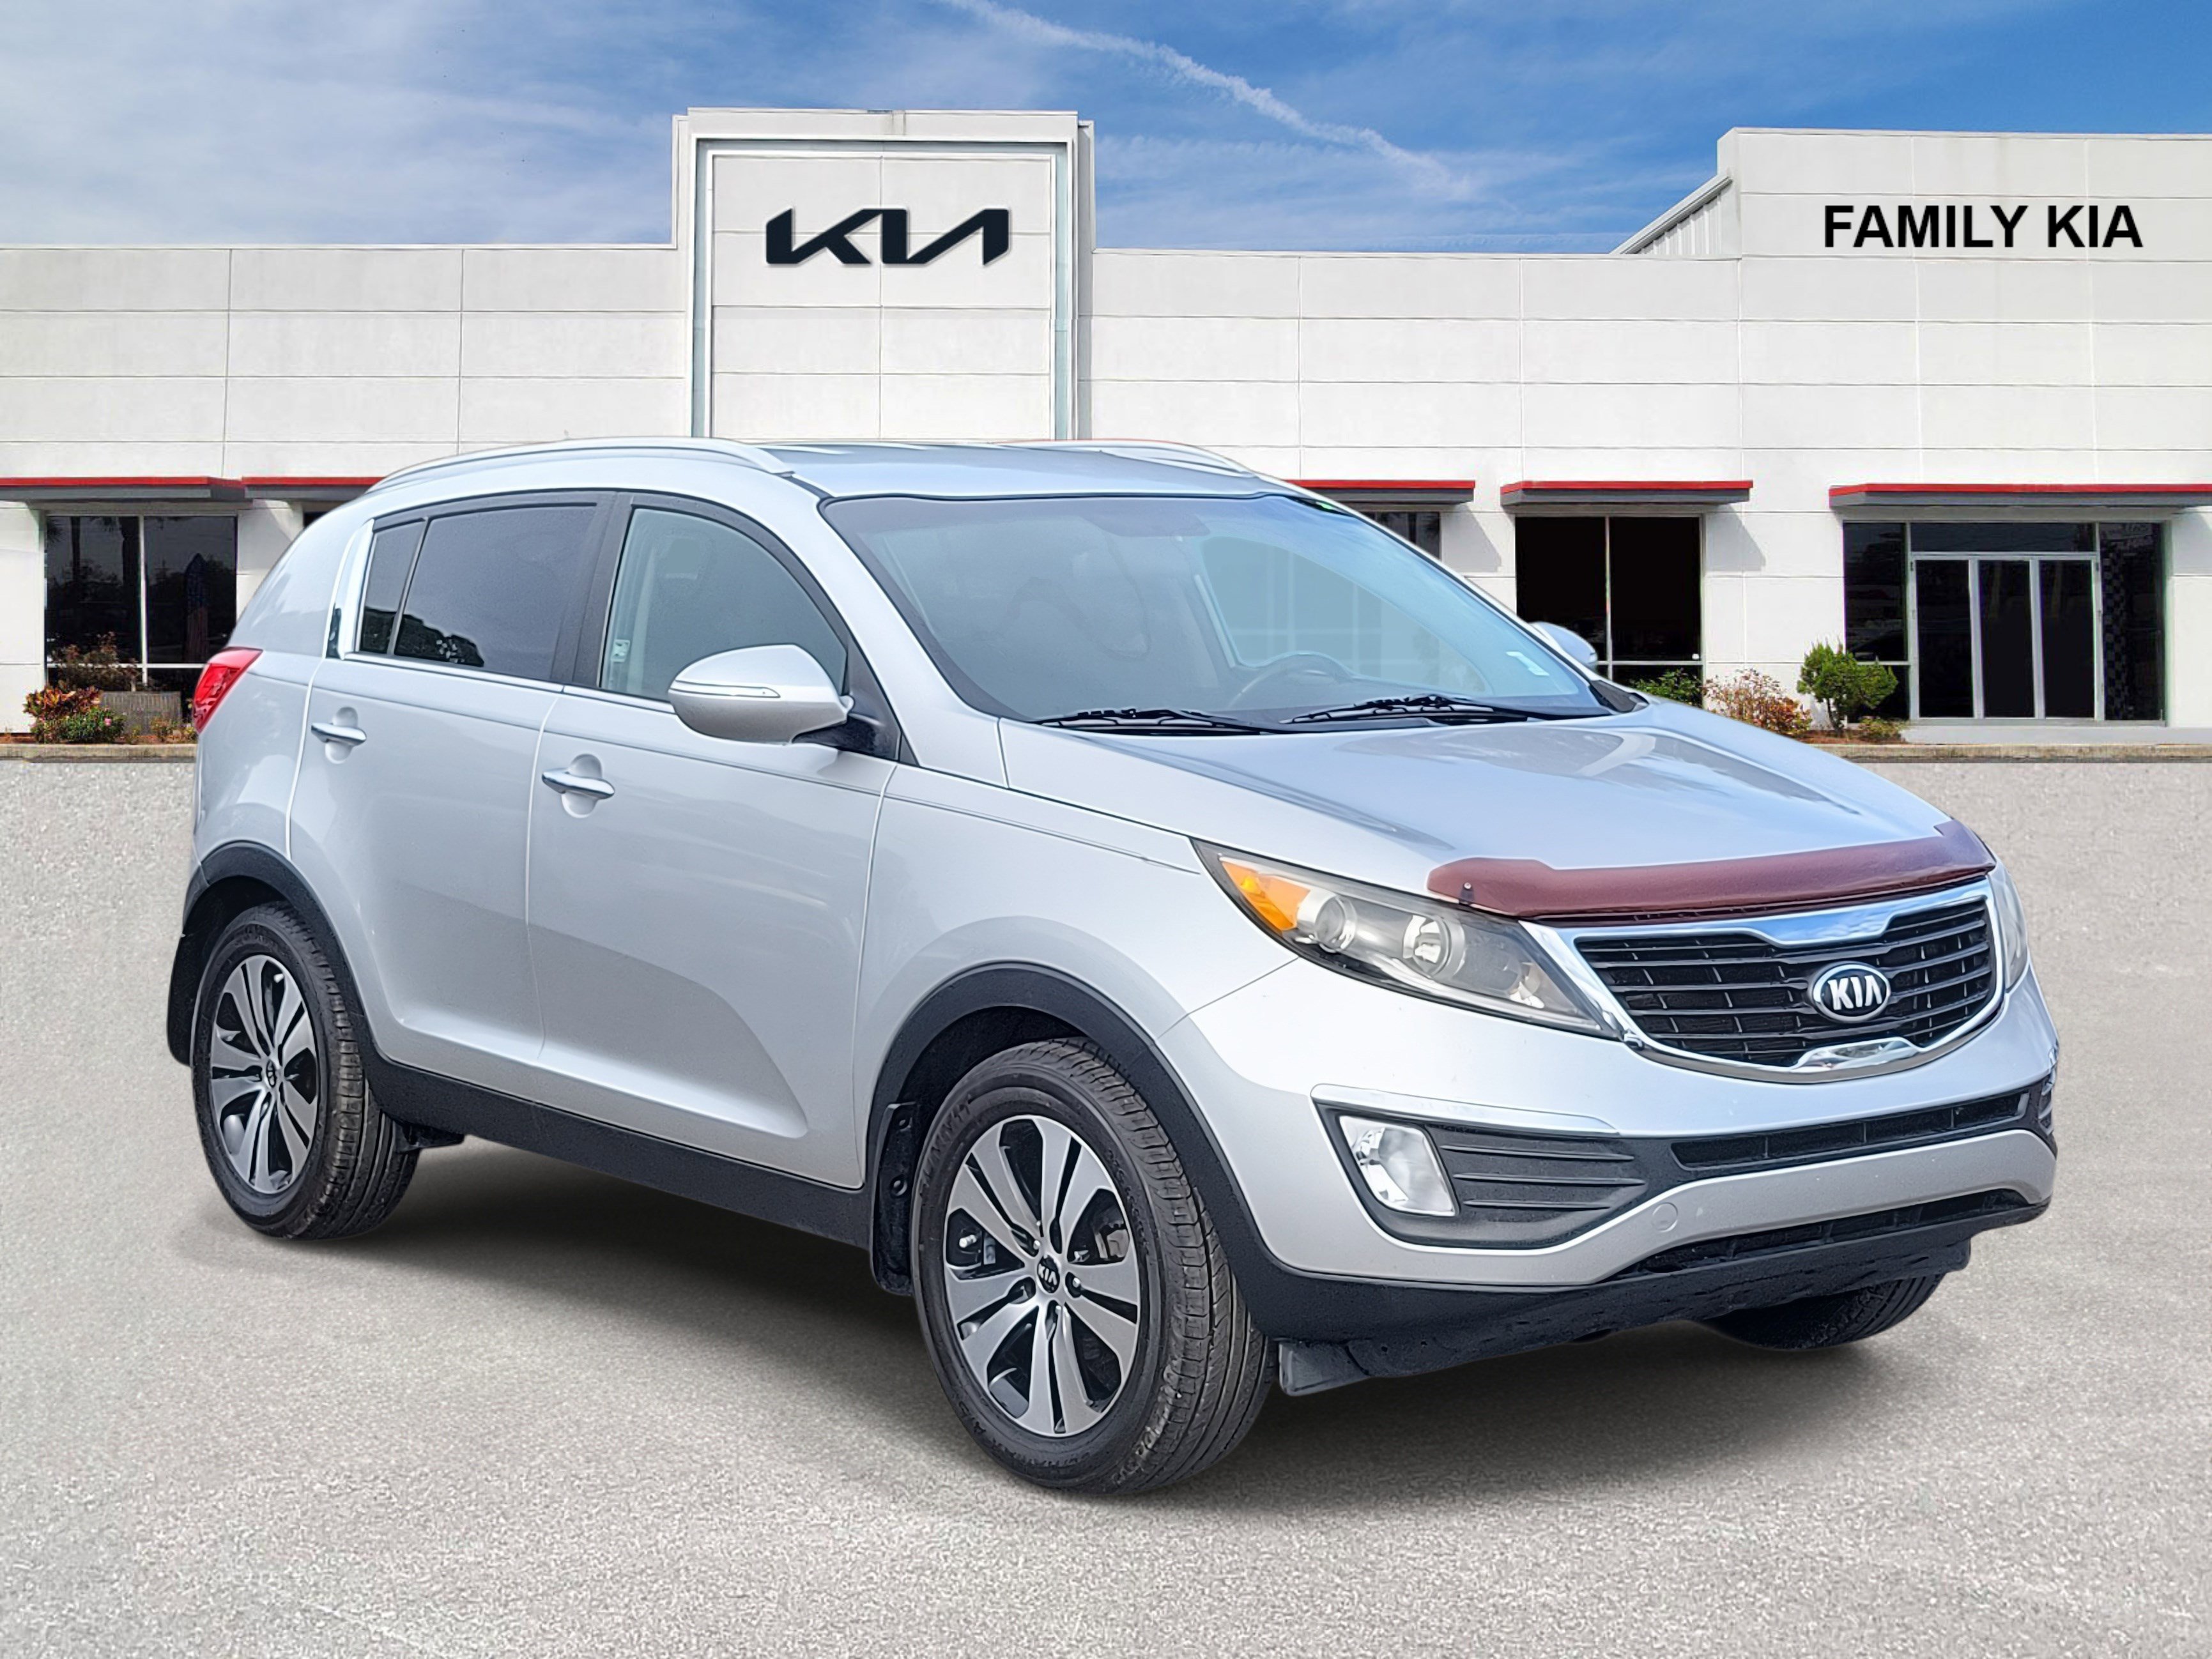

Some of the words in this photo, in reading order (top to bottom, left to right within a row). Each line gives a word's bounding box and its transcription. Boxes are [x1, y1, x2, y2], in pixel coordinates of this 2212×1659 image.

[1824, 205, 2029, 248] FAMILY
[2047, 205, 2144, 248] KIA
[1827, 975, 1882, 1011] KIA
[1038, 1263, 1058, 1286] KIA
